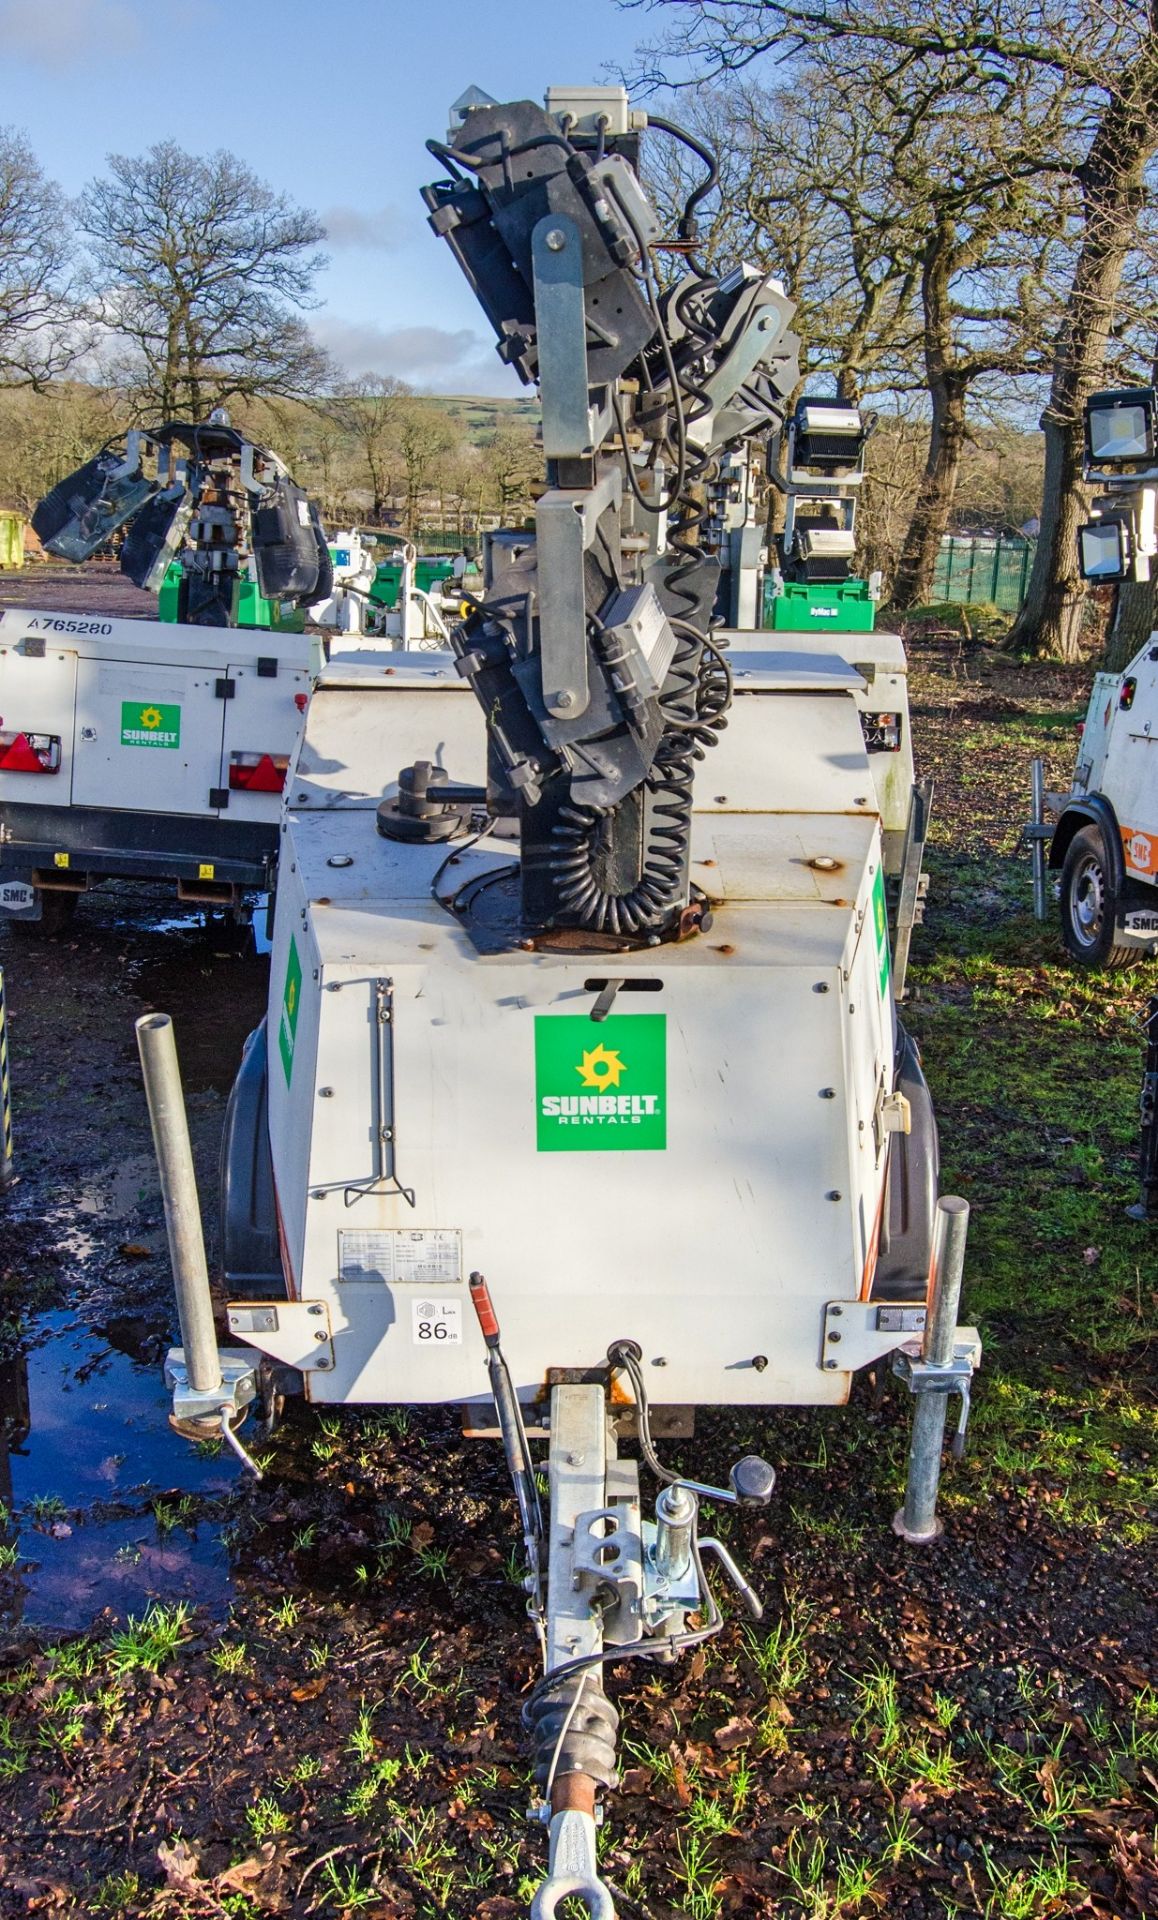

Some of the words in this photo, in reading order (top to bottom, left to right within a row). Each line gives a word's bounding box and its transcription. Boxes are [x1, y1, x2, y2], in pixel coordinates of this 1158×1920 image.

[27, 618, 113, 635] A765280
[122, 729, 177, 742] SUNBELT
[3, 888, 28, 903] SMC
[1132, 917, 1158, 931] SMC
[541, 1095, 659, 1116] SUNBELT
[558, 1115, 641, 1125] RENTALS
